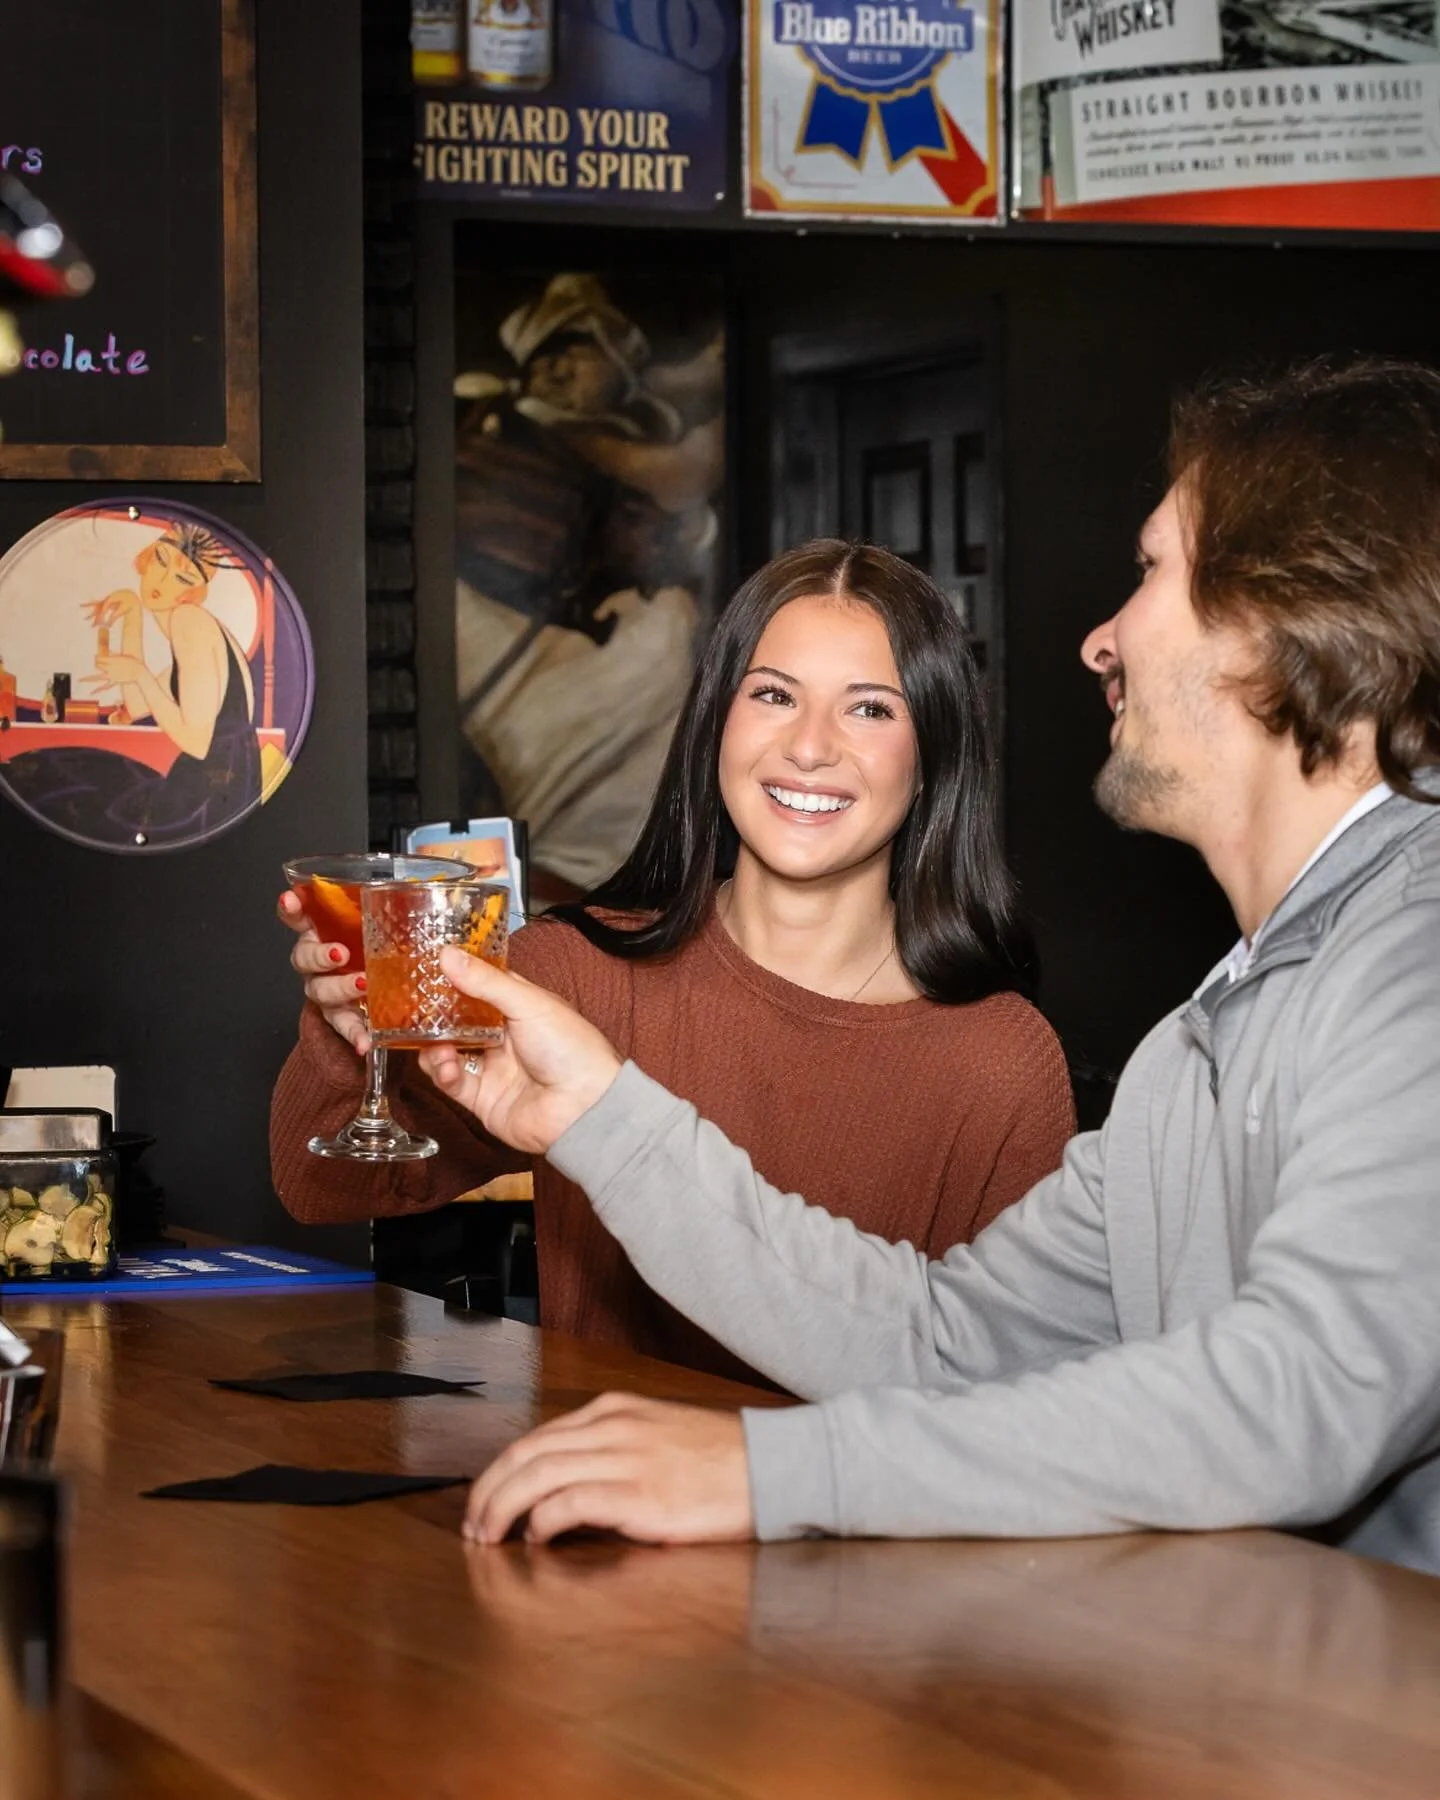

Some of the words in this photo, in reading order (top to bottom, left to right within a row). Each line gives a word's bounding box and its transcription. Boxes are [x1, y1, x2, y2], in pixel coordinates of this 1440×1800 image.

[781, 2, 851, 43] Blue
[855, 4, 968, 48] Ribbon
[1073, 0, 1176, 59] WHISKEY
[847, 49, 902, 64] BEER
[1082, 90, 1189, 124] STRAIGHT
[1206, 84, 1321, 111] BOURBON
[1335, 79, 1423, 102] WHISKEY
[425, 101, 569, 143] REWARD
[577, 108, 670, 149] YOUR
[577, 151, 690, 192] SPIRIT
[24, 333, 149, 375] colate
